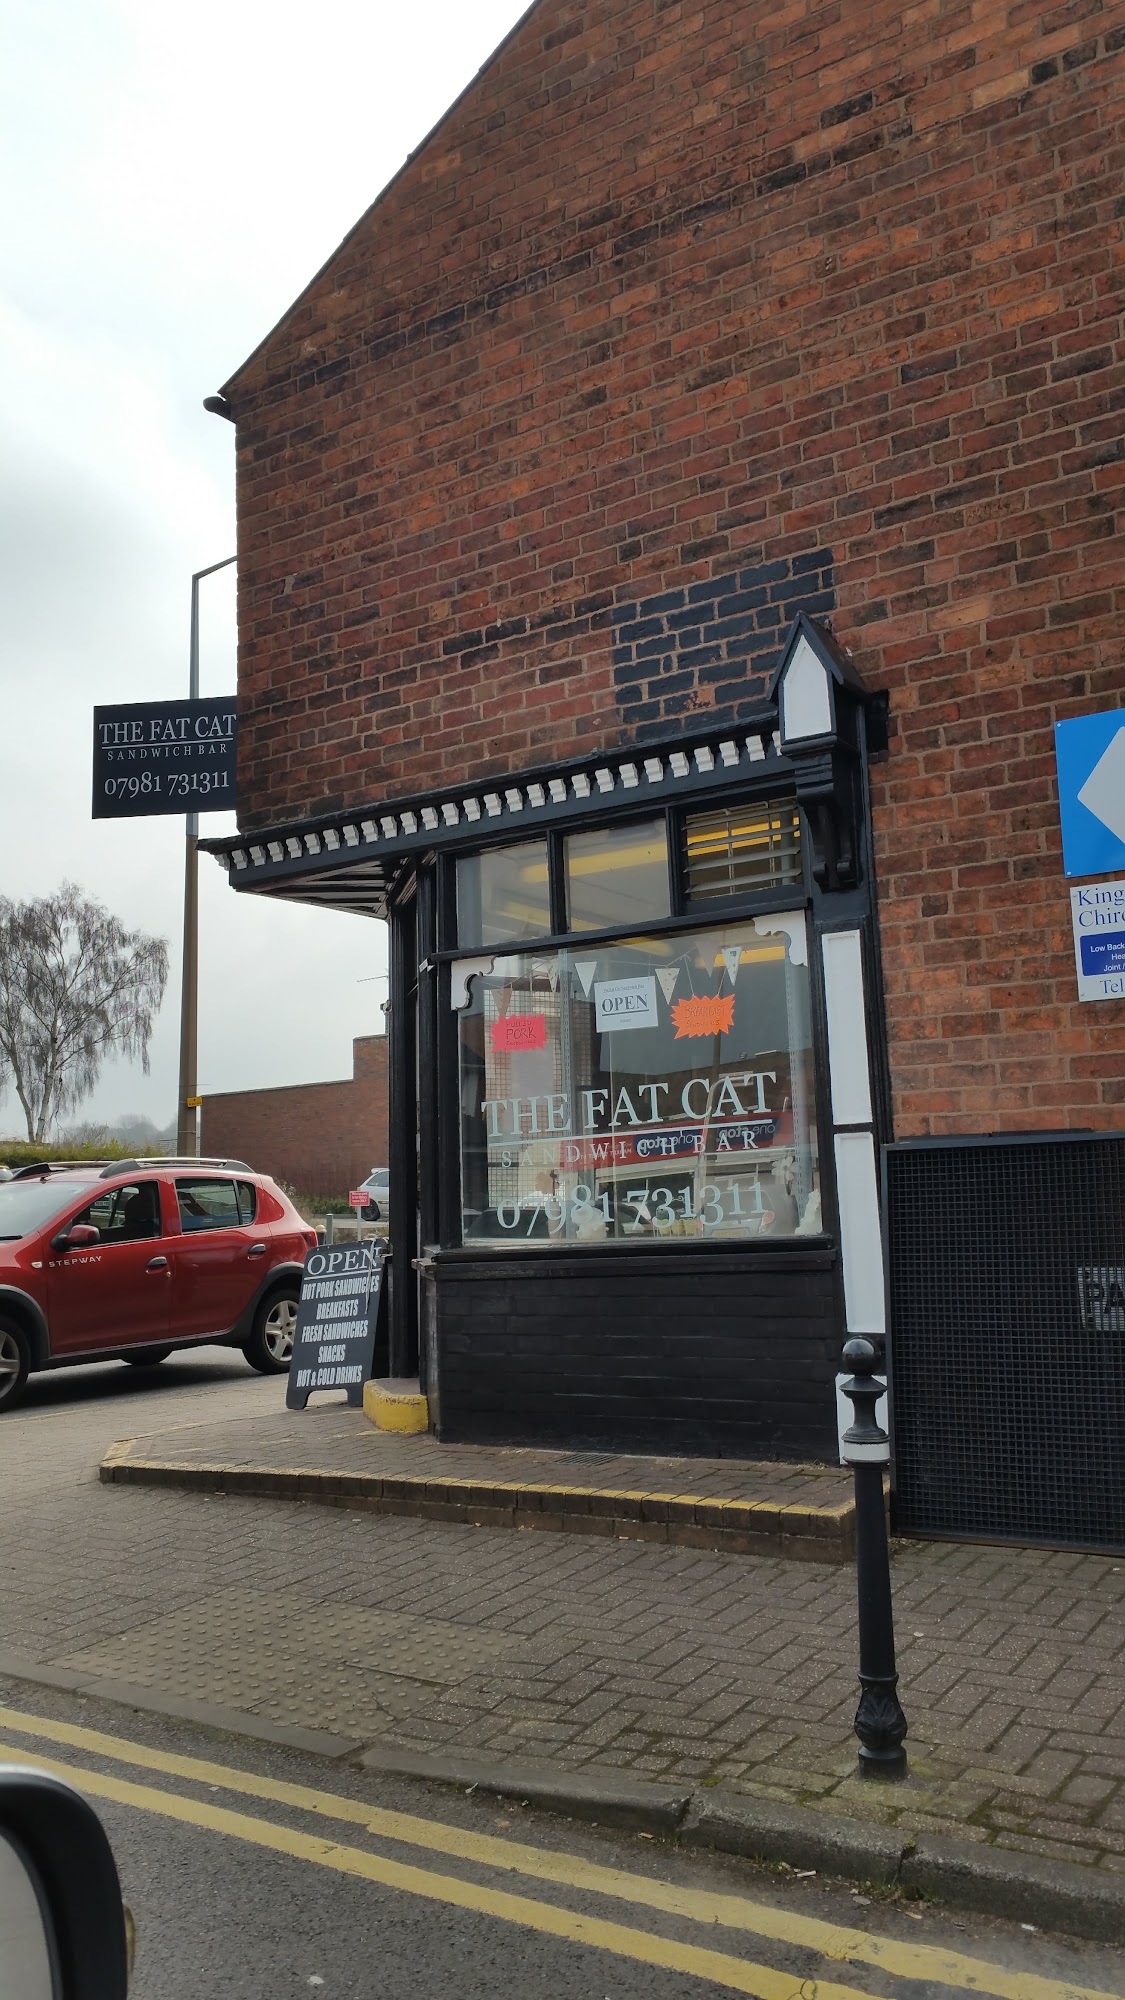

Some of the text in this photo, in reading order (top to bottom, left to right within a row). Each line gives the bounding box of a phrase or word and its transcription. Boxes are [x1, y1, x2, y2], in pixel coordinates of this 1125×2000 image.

[99, 714, 237, 744] THE FAT CAT
[107, 743, 227, 761] SANDWICH BAR
[104, 770, 229, 799] 07981 731311
[1090, 945, 1106, 953] Low
[1103, 964, 1121, 972] Joint
[1099, 977, 1124, 995] Tel
[601, 993, 648, 1013] OPEN
[506, 1027, 537, 1040] PORK
[481, 1071, 777, 1137] THE FAT CAT
[501, 1137, 678, 1168] SANDWICH
[693, 1130, 759, 1154] BAR
[496, 1181, 771, 1236] 07981 731311
[48, 1255, 102, 1268] STEPWAY
[307, 1246, 382, 1275] OPEN
[301, 1282, 317, 1300] HOT
[315, 1280, 335, 1299] PORK
[316, 1298, 359, 1320] BREAKFASTS
[301, 1319, 369, 1343] FRESH SANDWICHES
[317, 1343, 346, 1364] SNACKS
[296, 1364, 363, 1388] HOT & COLD DRINKS
